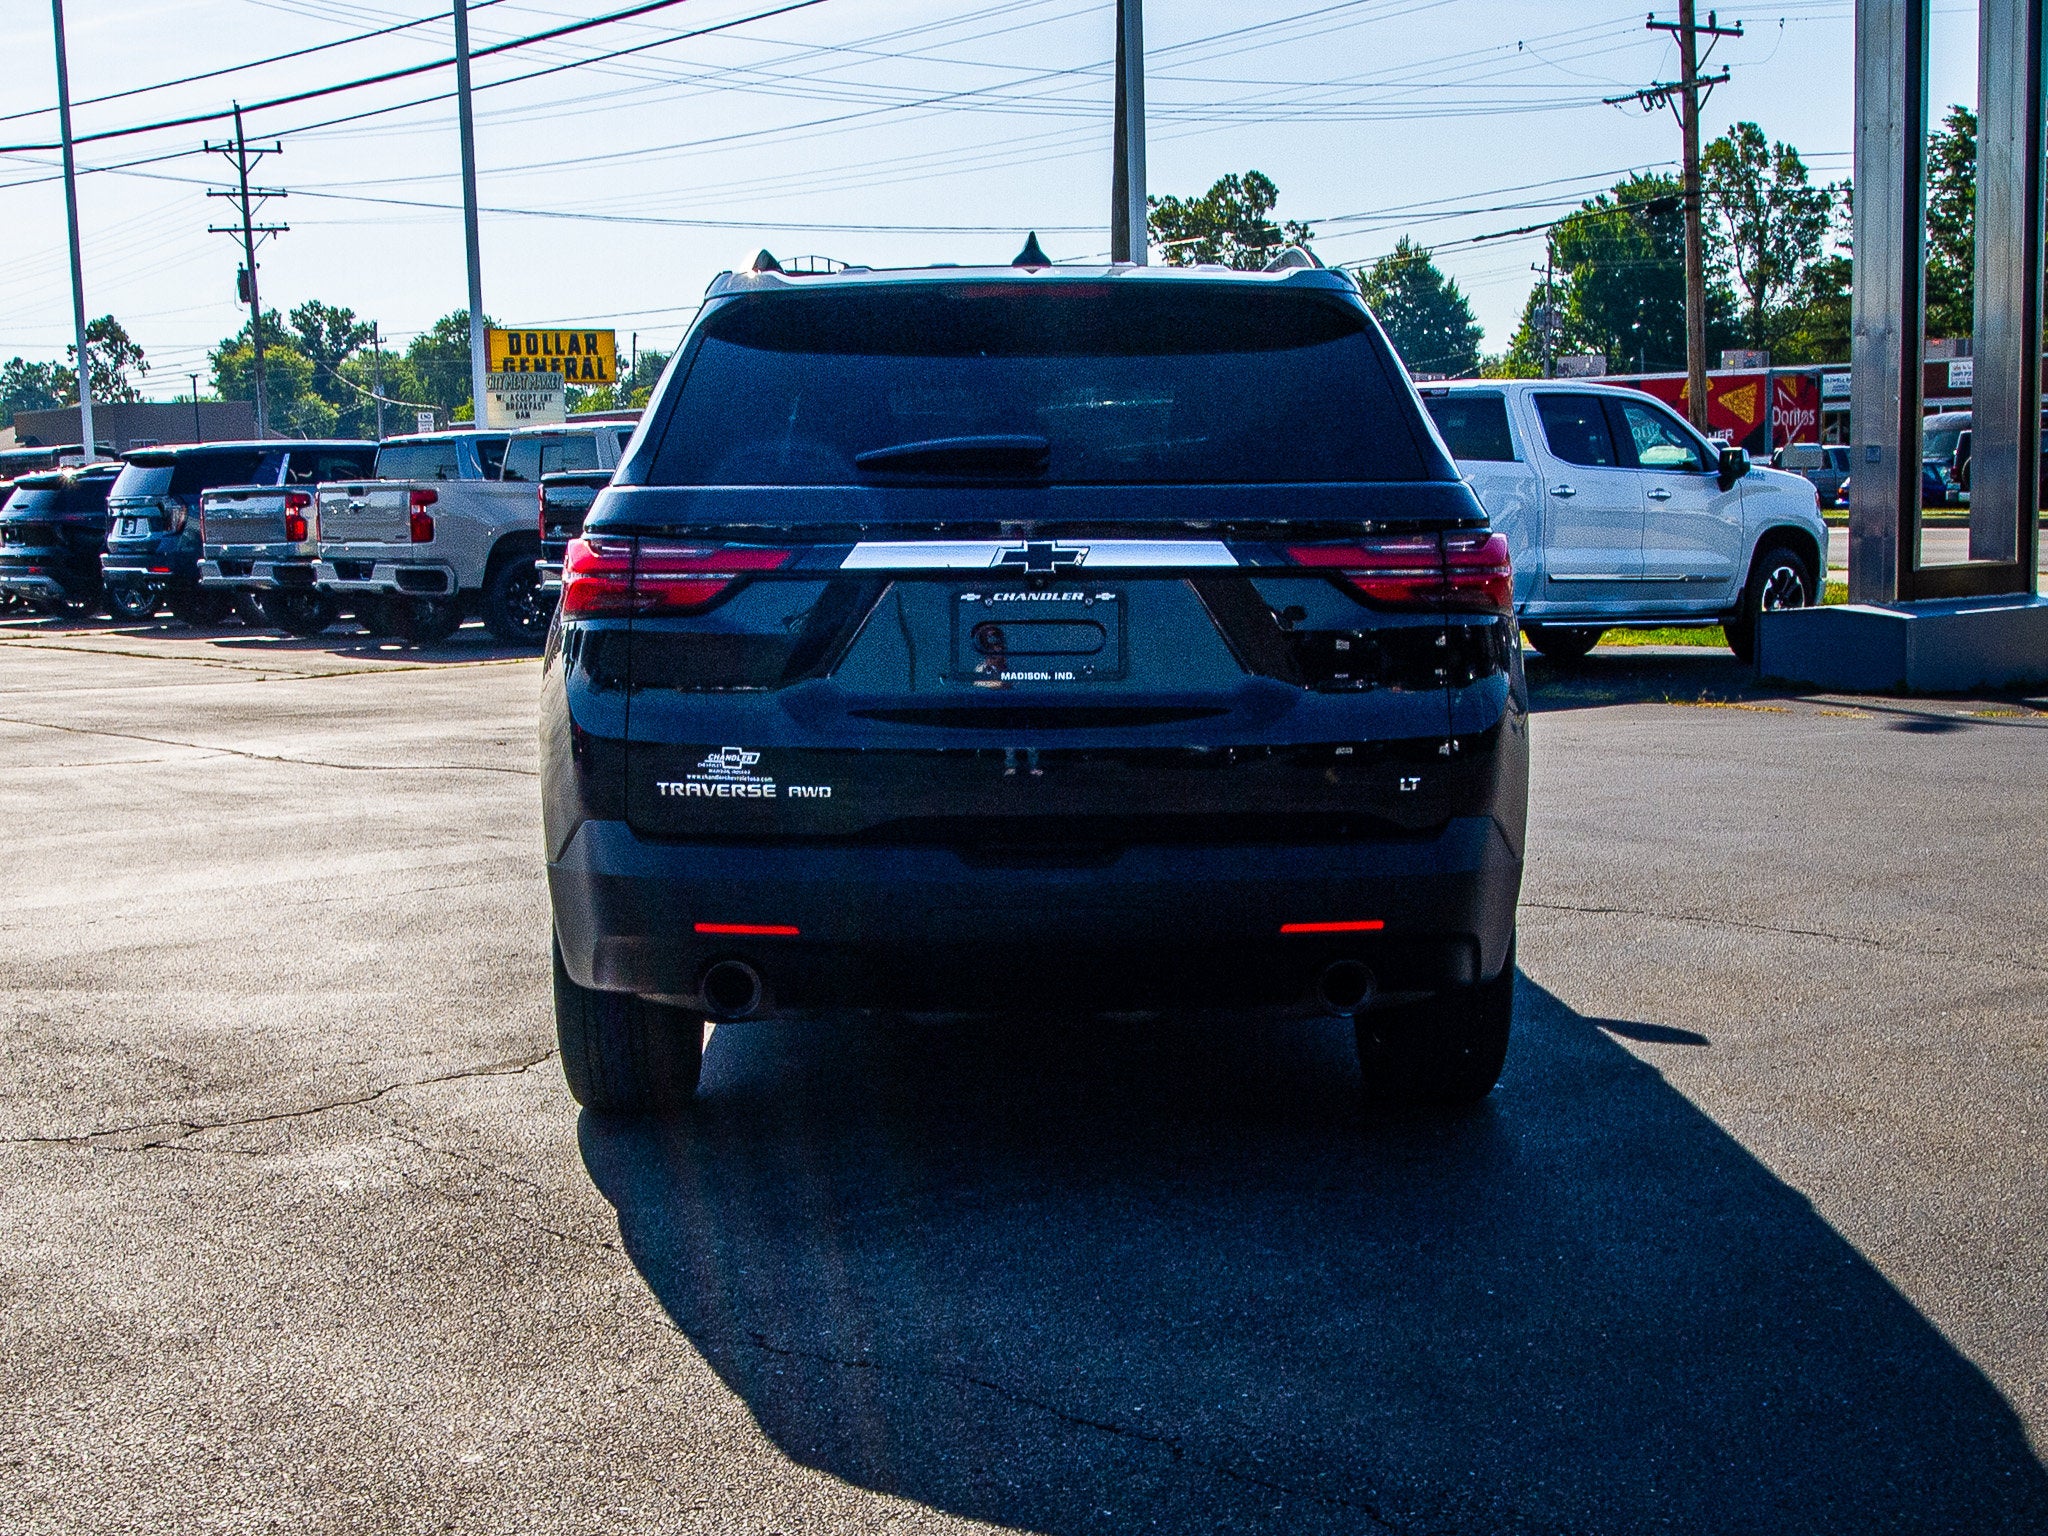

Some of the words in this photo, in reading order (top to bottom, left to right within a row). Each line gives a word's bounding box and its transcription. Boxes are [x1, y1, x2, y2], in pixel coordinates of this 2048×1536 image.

[507, 332, 598, 355] DOLLAR
[502, 356, 607, 380] GENERAL
[505, 402, 546, 411] BREAKFAST
[1772, 405, 1815, 426] Doritos
[993, 592, 1084, 601] CHANDLER
[1054, 671, 1076, 681] IND.
[707, 753, 753, 762] CHANDLER
[656, 782, 777, 798] TRAVERSE
[788, 786, 831, 798] AWD
[1400, 777, 1421, 791] LT
